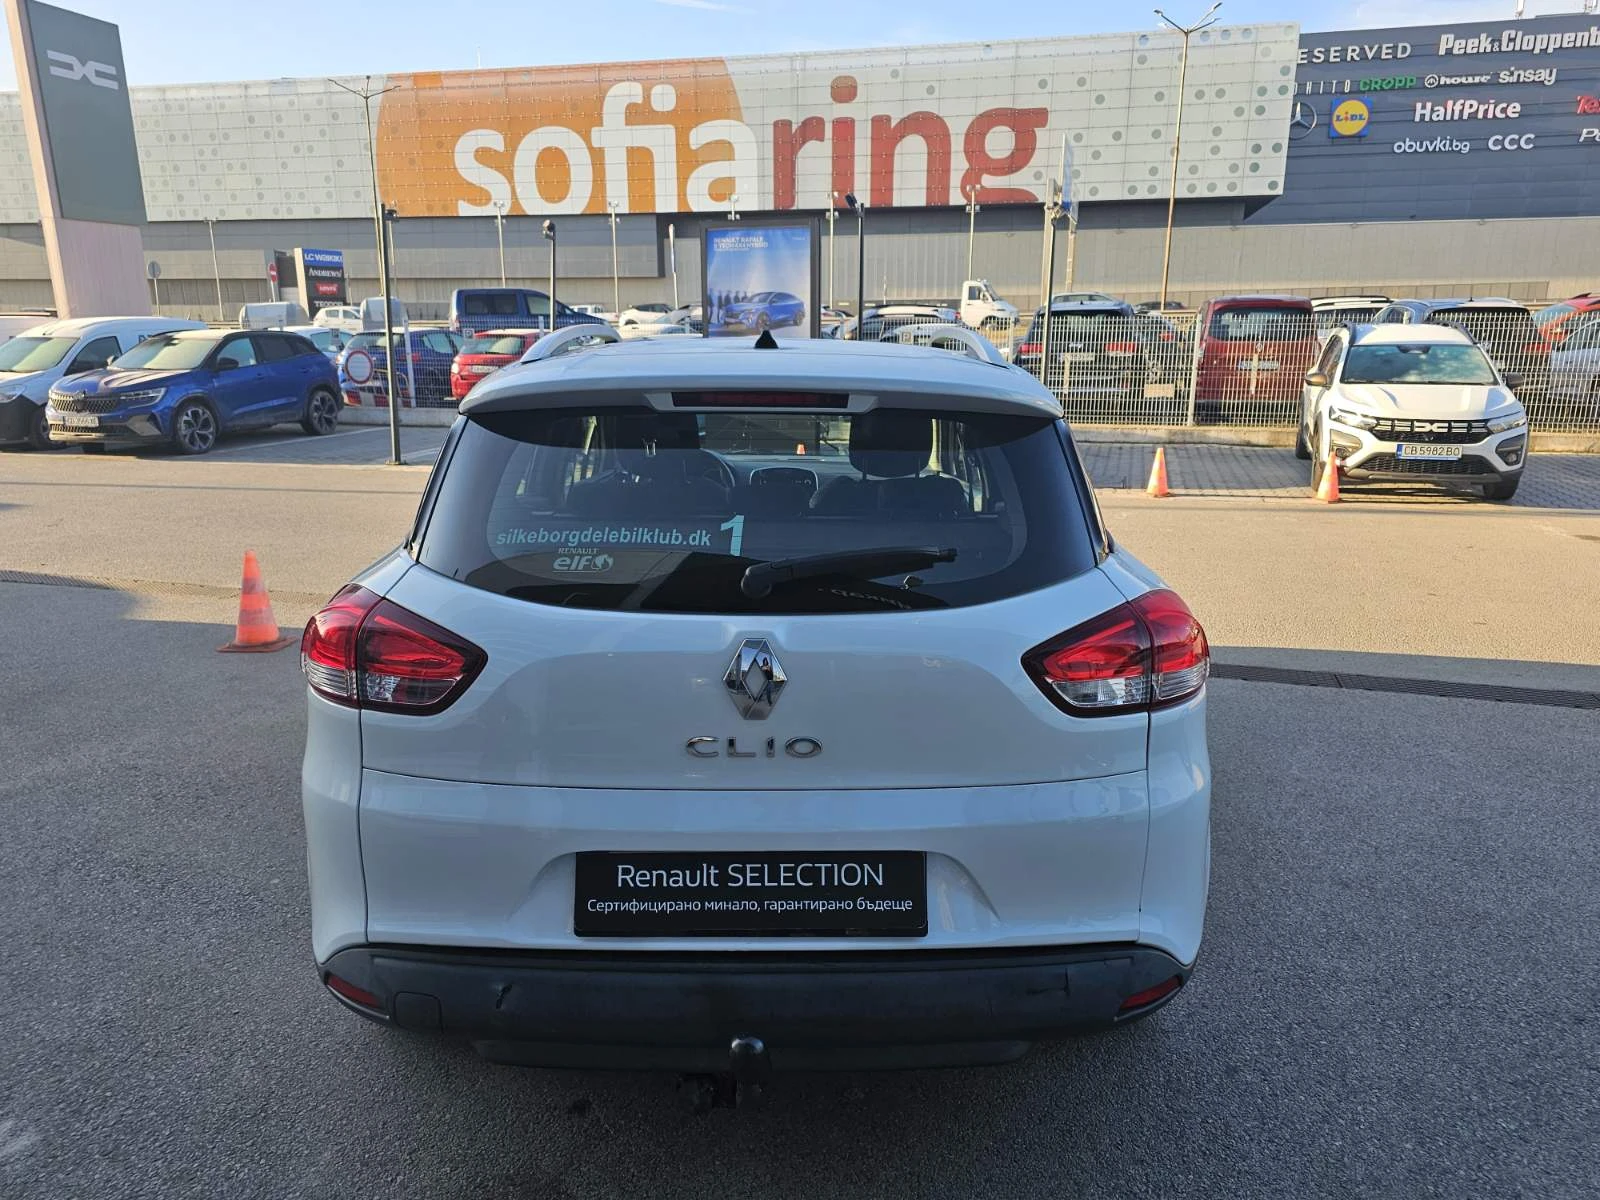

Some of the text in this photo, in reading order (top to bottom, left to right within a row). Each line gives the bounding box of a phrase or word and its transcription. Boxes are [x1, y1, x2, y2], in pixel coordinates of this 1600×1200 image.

[1360, 75, 1417, 91] CROPP
[1499, 67, 1557, 85] sinsay
[1414, 99, 1521, 122] HalfPrice
[1393, 136, 1470, 154] obuvki.bg
[1488, 134, 1535, 151] CCC
[496, 526, 711, 546] silkeborgdelebilklub.dk
[720, 514, 745, 557] 1
[558, 547, 599, 555] RENAULT
[686, 736, 823, 758] CLIO
[617, 863, 884, 888] Renault SELECTION
[587, 897, 913, 914] Сертифицирано минало, гарантирано бъдеще
